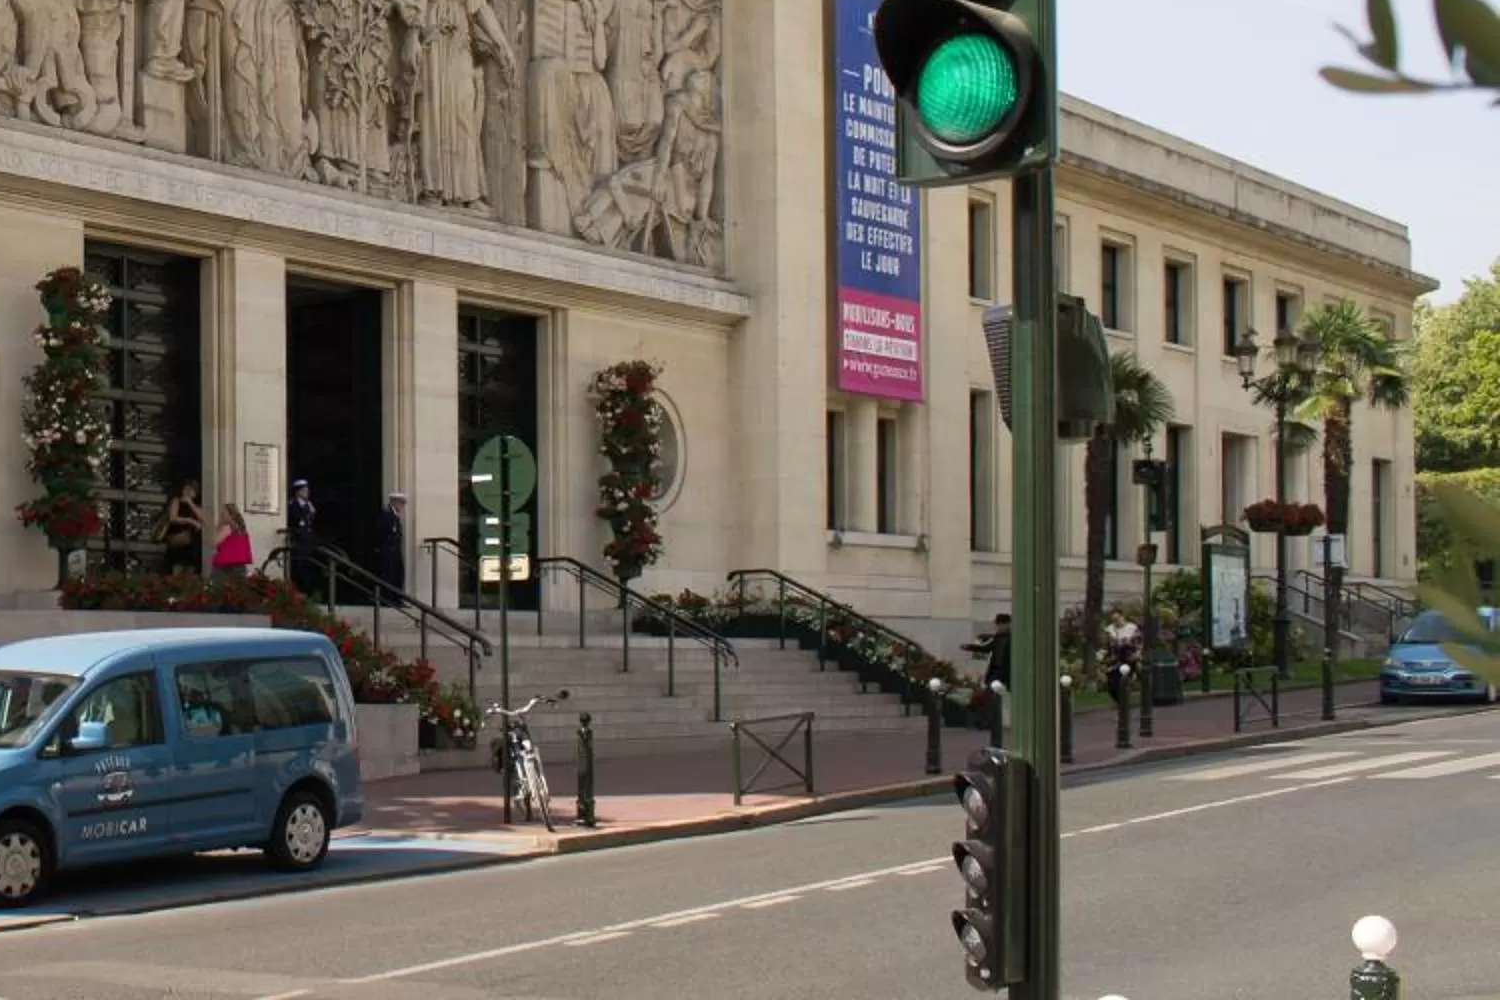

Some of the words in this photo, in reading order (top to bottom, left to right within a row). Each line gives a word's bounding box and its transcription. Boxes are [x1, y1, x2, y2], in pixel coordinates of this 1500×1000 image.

[843, 90, 856, 113] LE
[847, 170, 861, 191] LA
[863, 175, 886, 197] NUIT
[845, 221, 865, 243] DES
[867, 226, 914, 255] EFFECTIFS
[861, 250, 872, 271] LE
[875, 254, 901, 277] JOUR
[80, 816, 148, 840] MOBICAR
